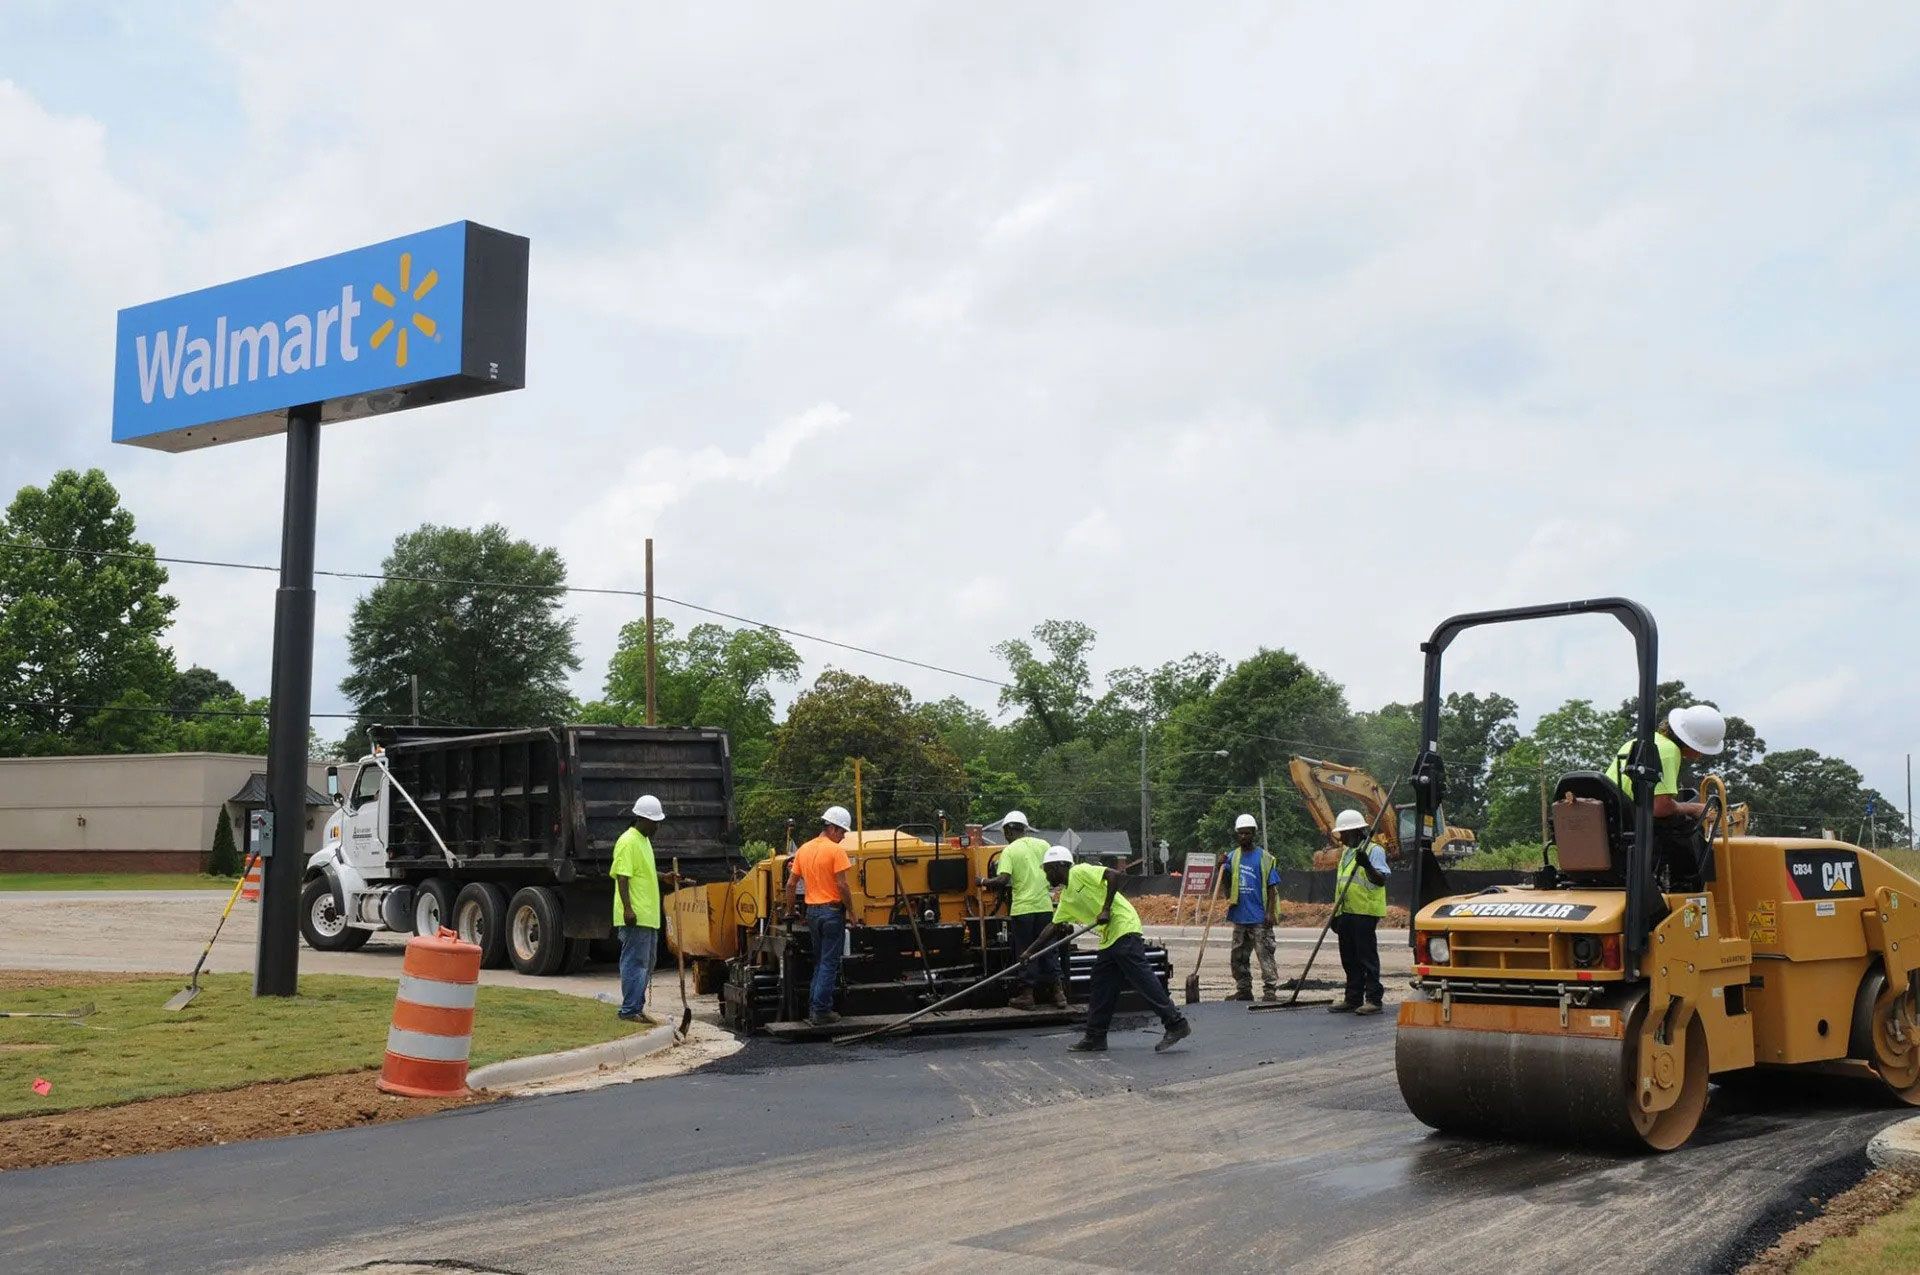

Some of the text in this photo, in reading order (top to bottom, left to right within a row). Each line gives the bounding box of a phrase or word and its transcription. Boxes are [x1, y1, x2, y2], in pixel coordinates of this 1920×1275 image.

[136, 285, 361, 404] Walmart
[1792, 863, 1813, 876] CB34
[1821, 861, 1854, 892] CAT
[1450, 902, 1575, 918] CATERPILLAR
